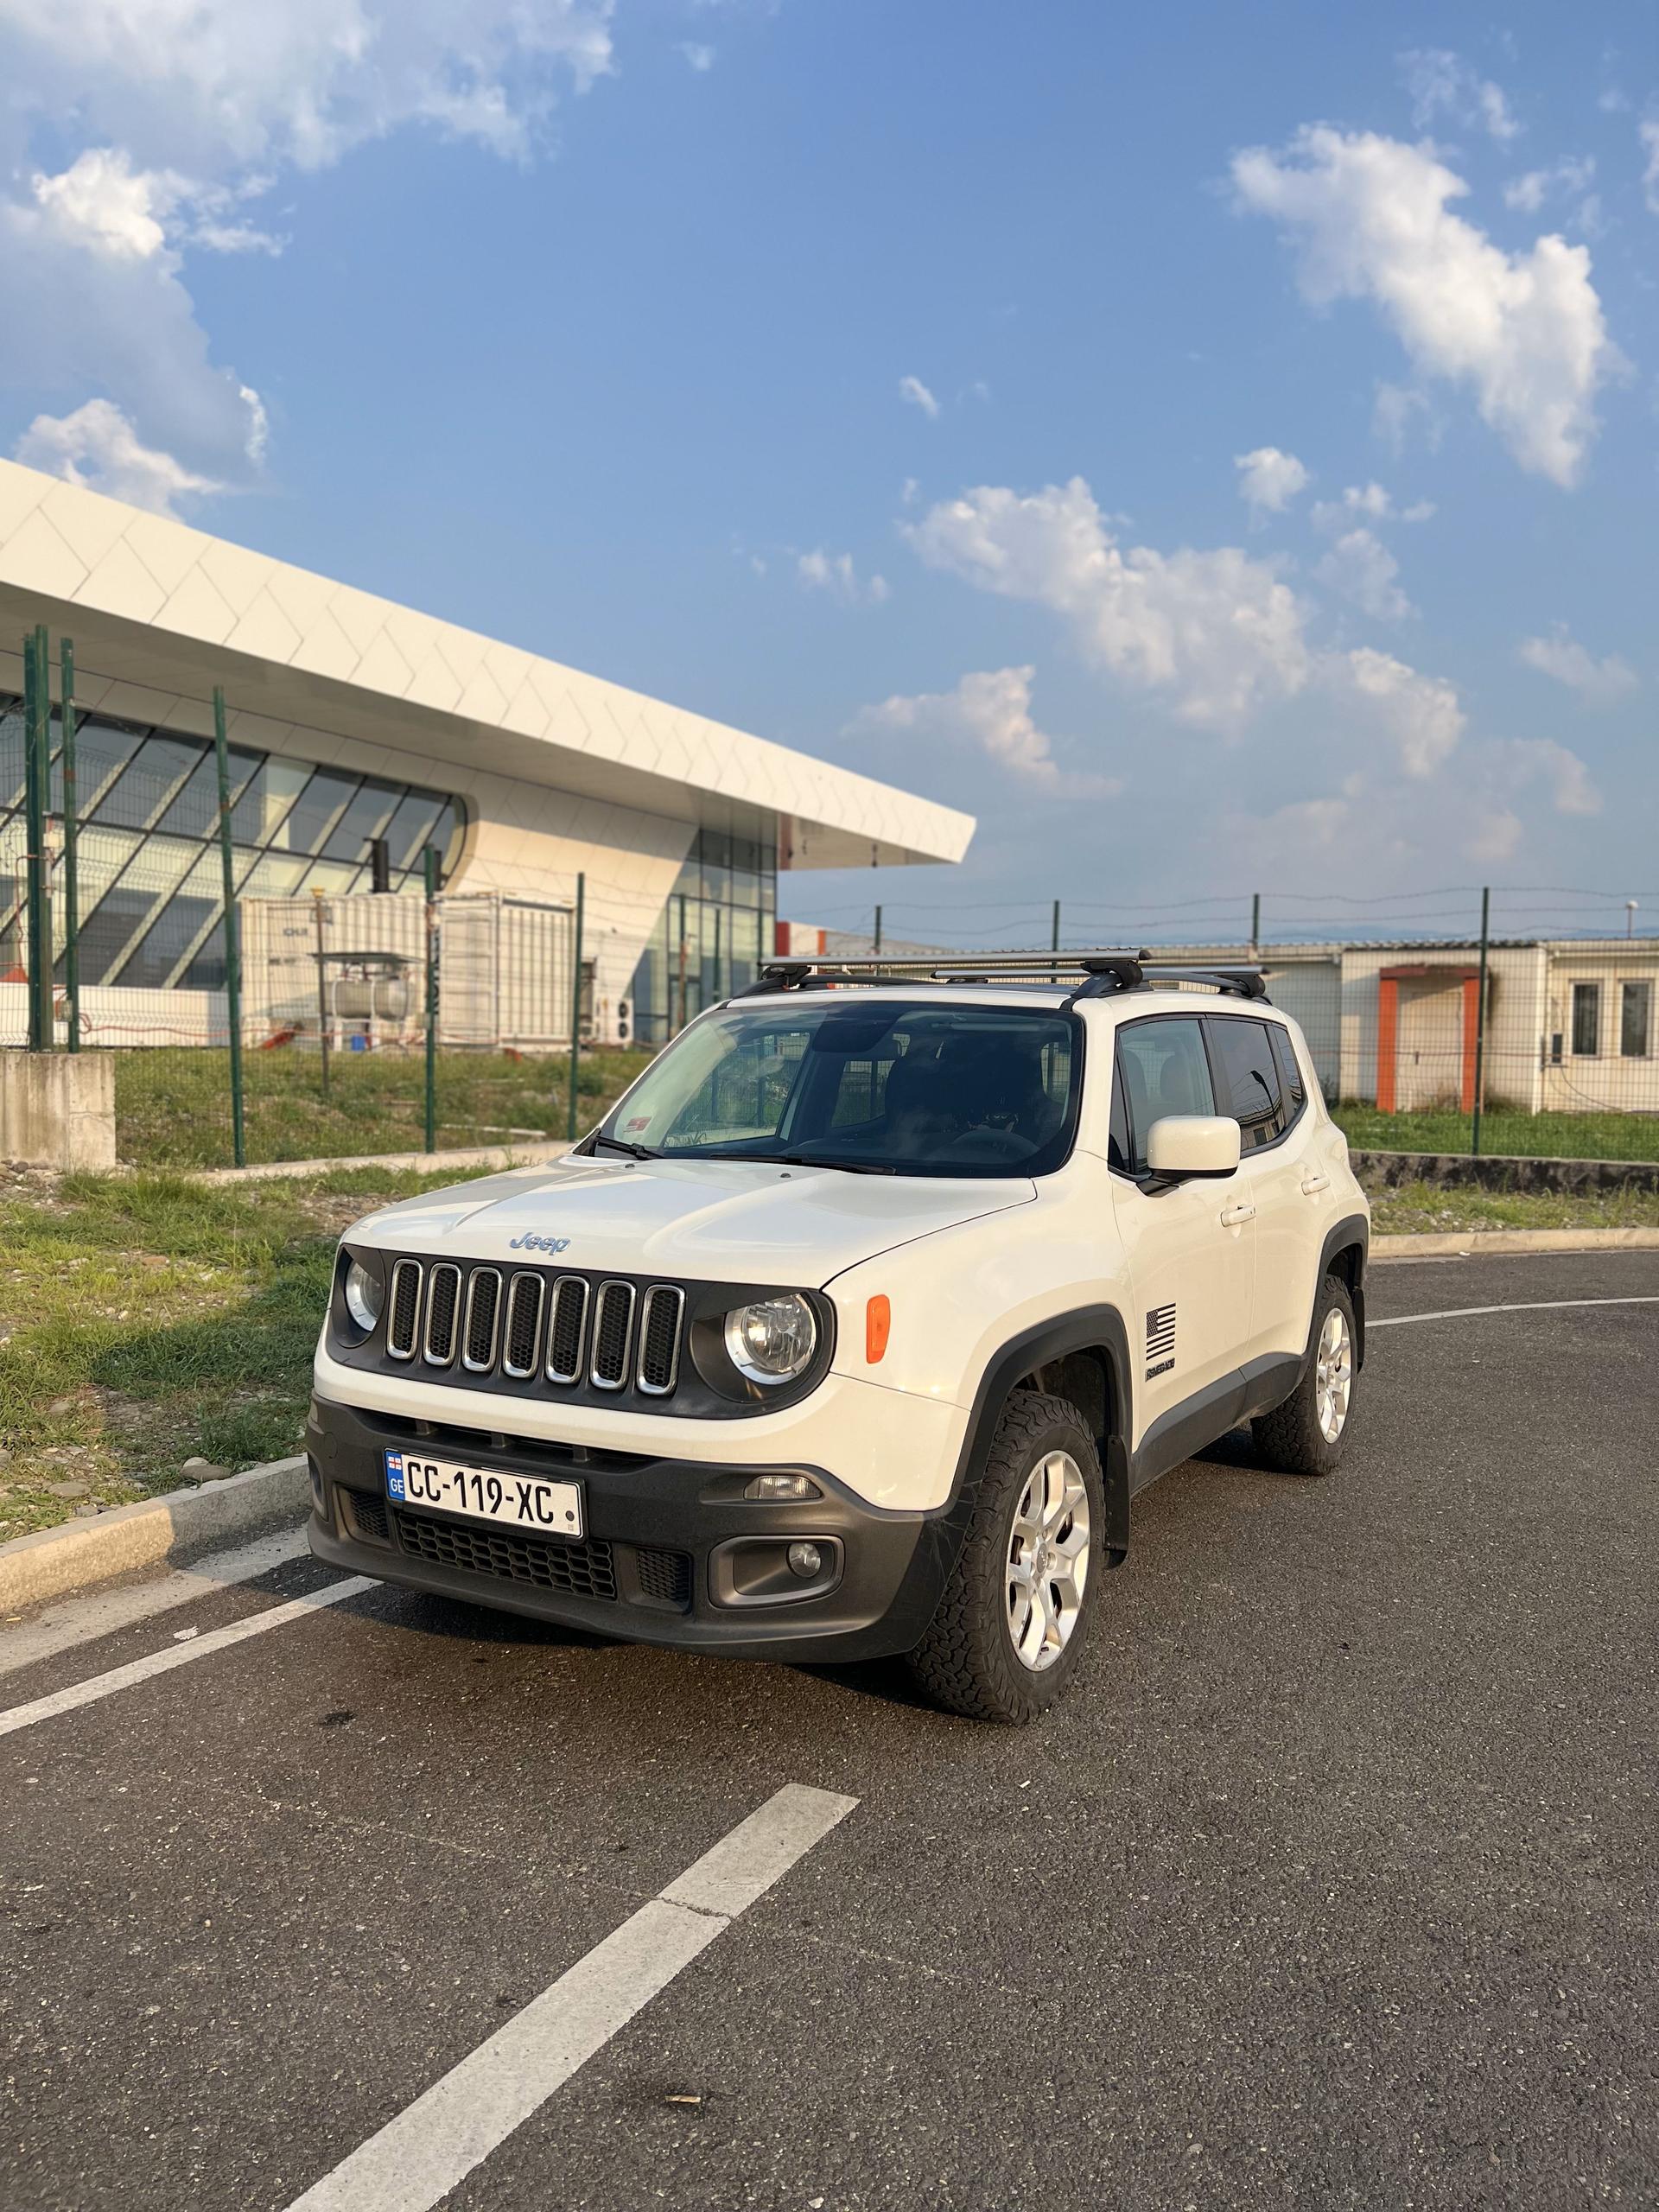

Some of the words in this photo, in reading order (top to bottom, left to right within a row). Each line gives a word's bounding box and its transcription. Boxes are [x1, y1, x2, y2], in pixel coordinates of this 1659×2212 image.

[510, 1231, 570, 1255] Jeep
[391, 1478, 404, 1494] GE
[407, 1461, 554, 1524] CC-119-XC
